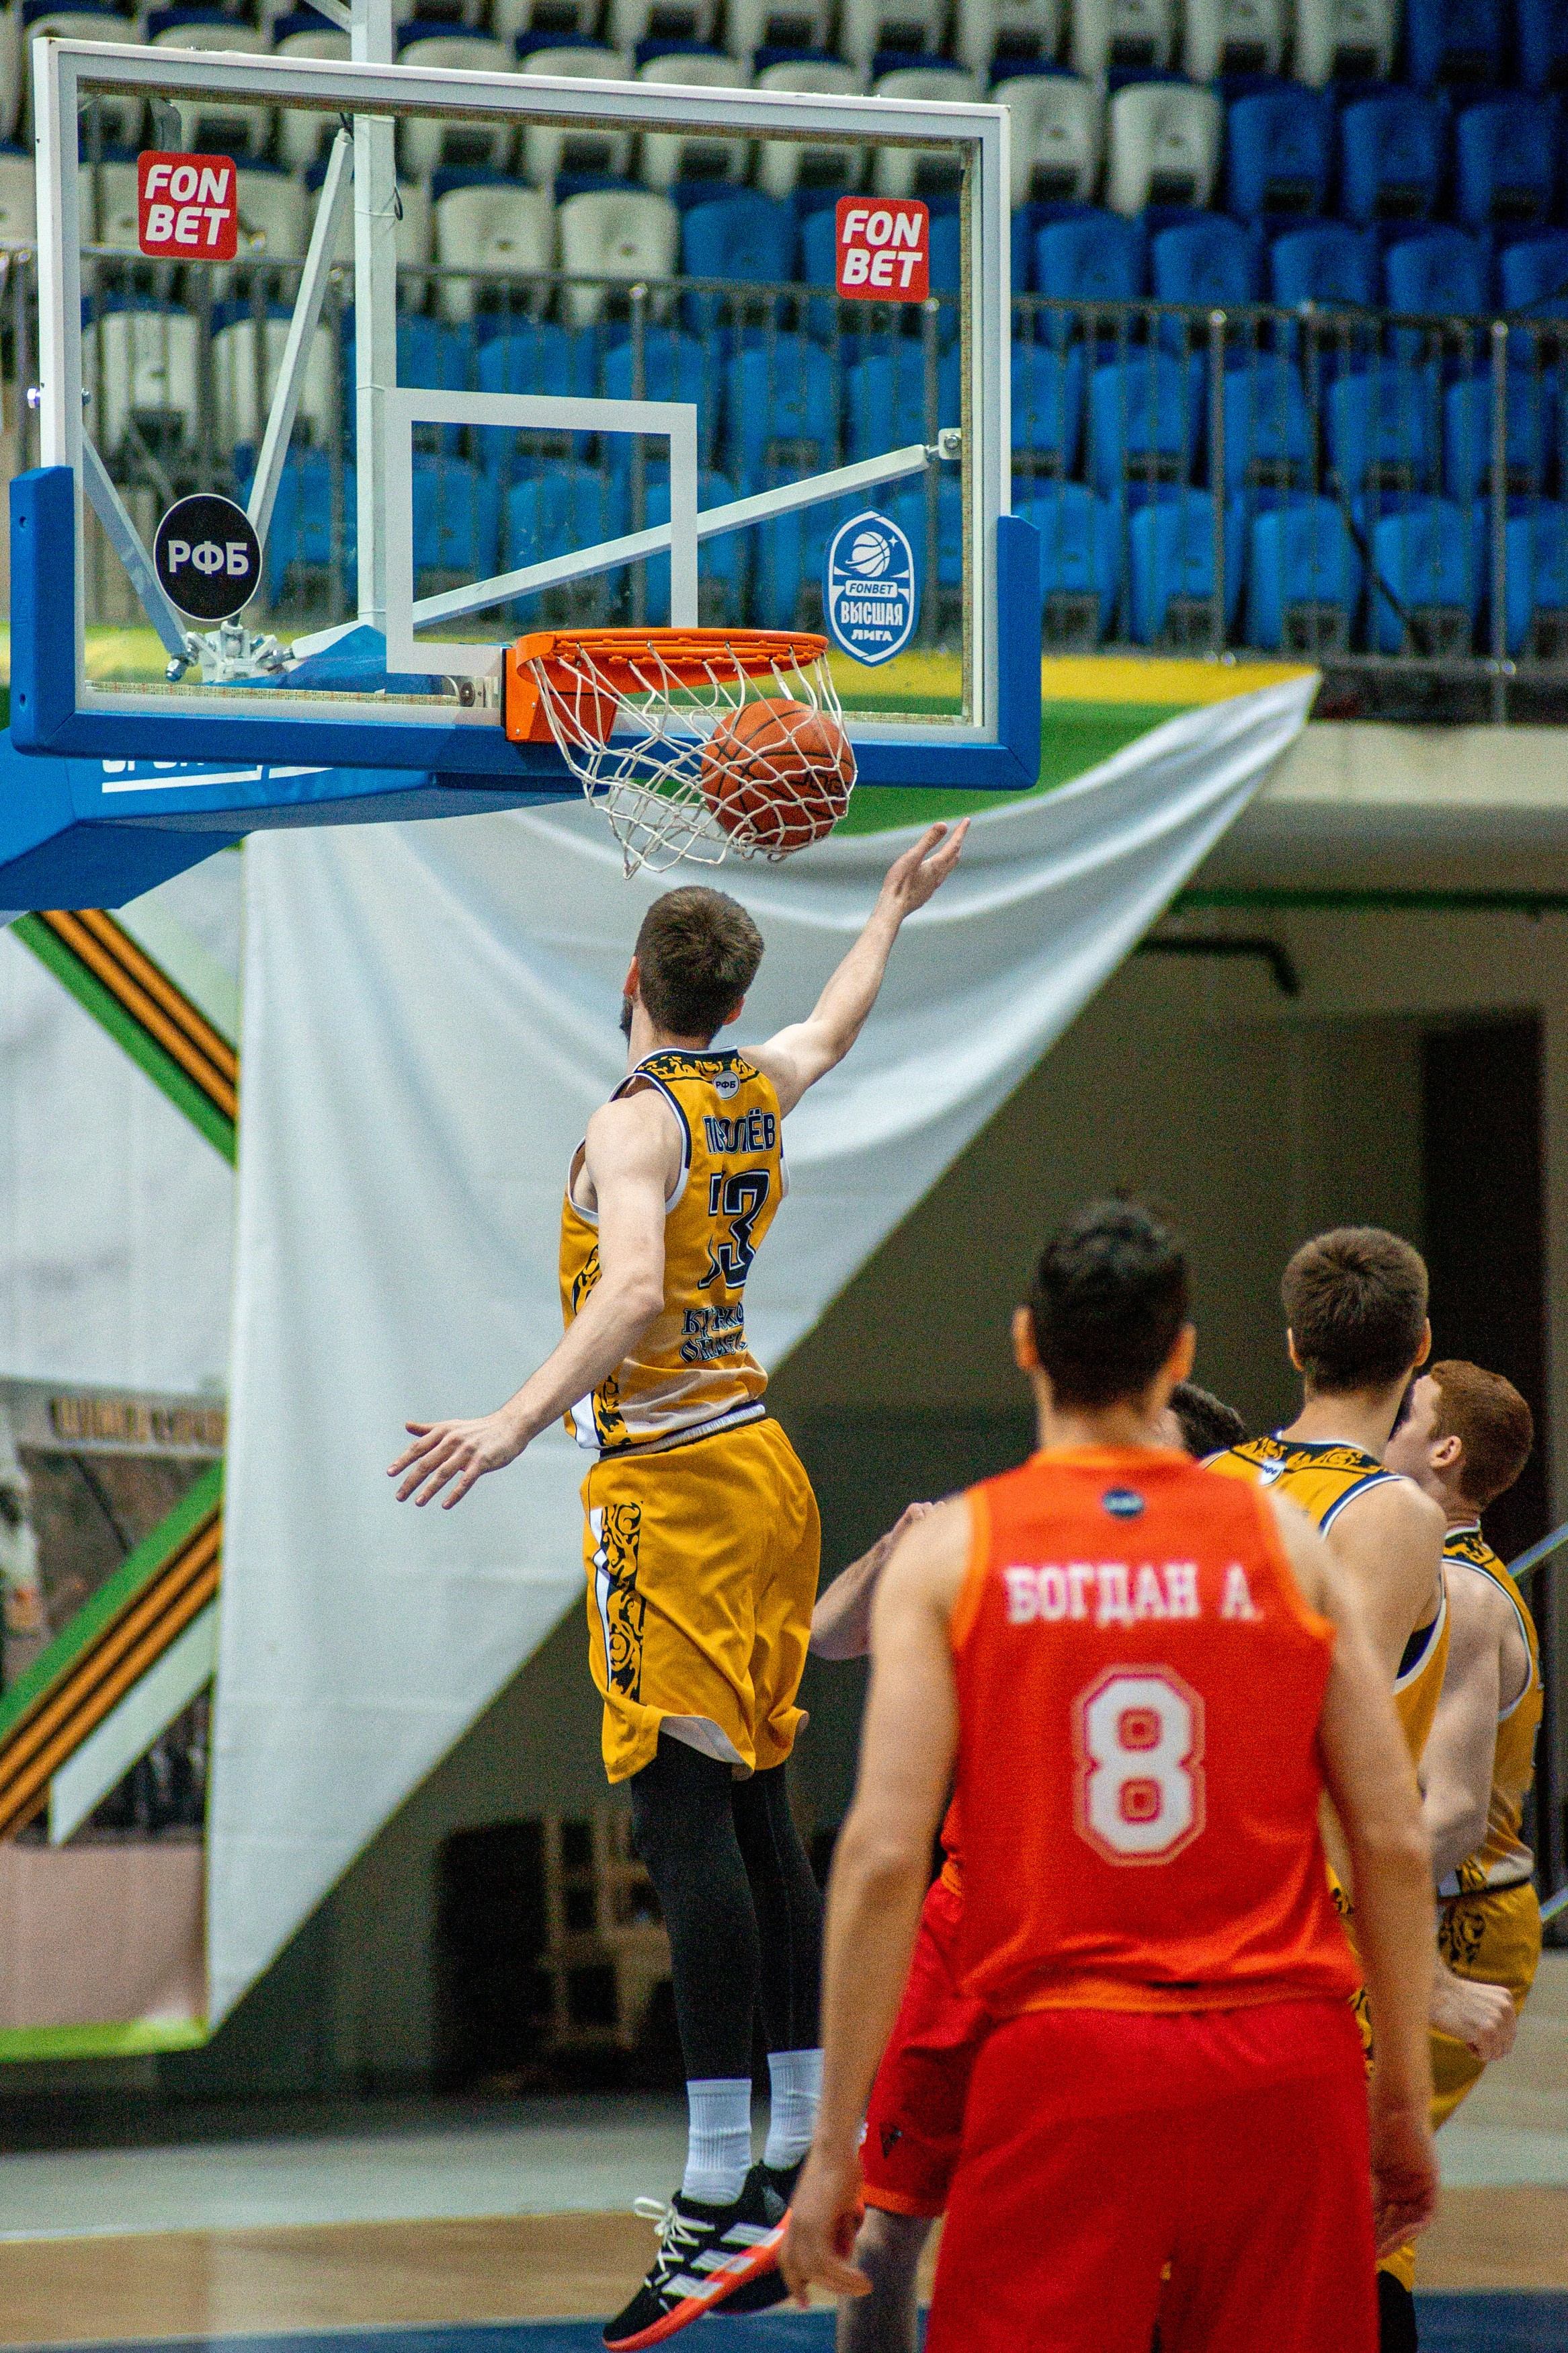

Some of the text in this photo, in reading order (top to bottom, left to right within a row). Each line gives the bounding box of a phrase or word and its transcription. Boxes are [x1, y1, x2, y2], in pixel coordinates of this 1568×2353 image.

[145, 164, 230, 204] FON
[145, 204, 231, 245] BET
[842, 209, 923, 247] FON
[842, 248, 923, 288] BET
[168, 540, 249, 575] РФБ
[850, 583, 894, 594] FONBET
[841, 600, 903, 626] ВЫСШАЯ
[851, 629, 893, 641] ЛИГА
[716, 1080, 736, 1088] РФБ
[1004, 1561, 1202, 1628] БОГДАН
[1072, 1663, 1205, 1866] 8
